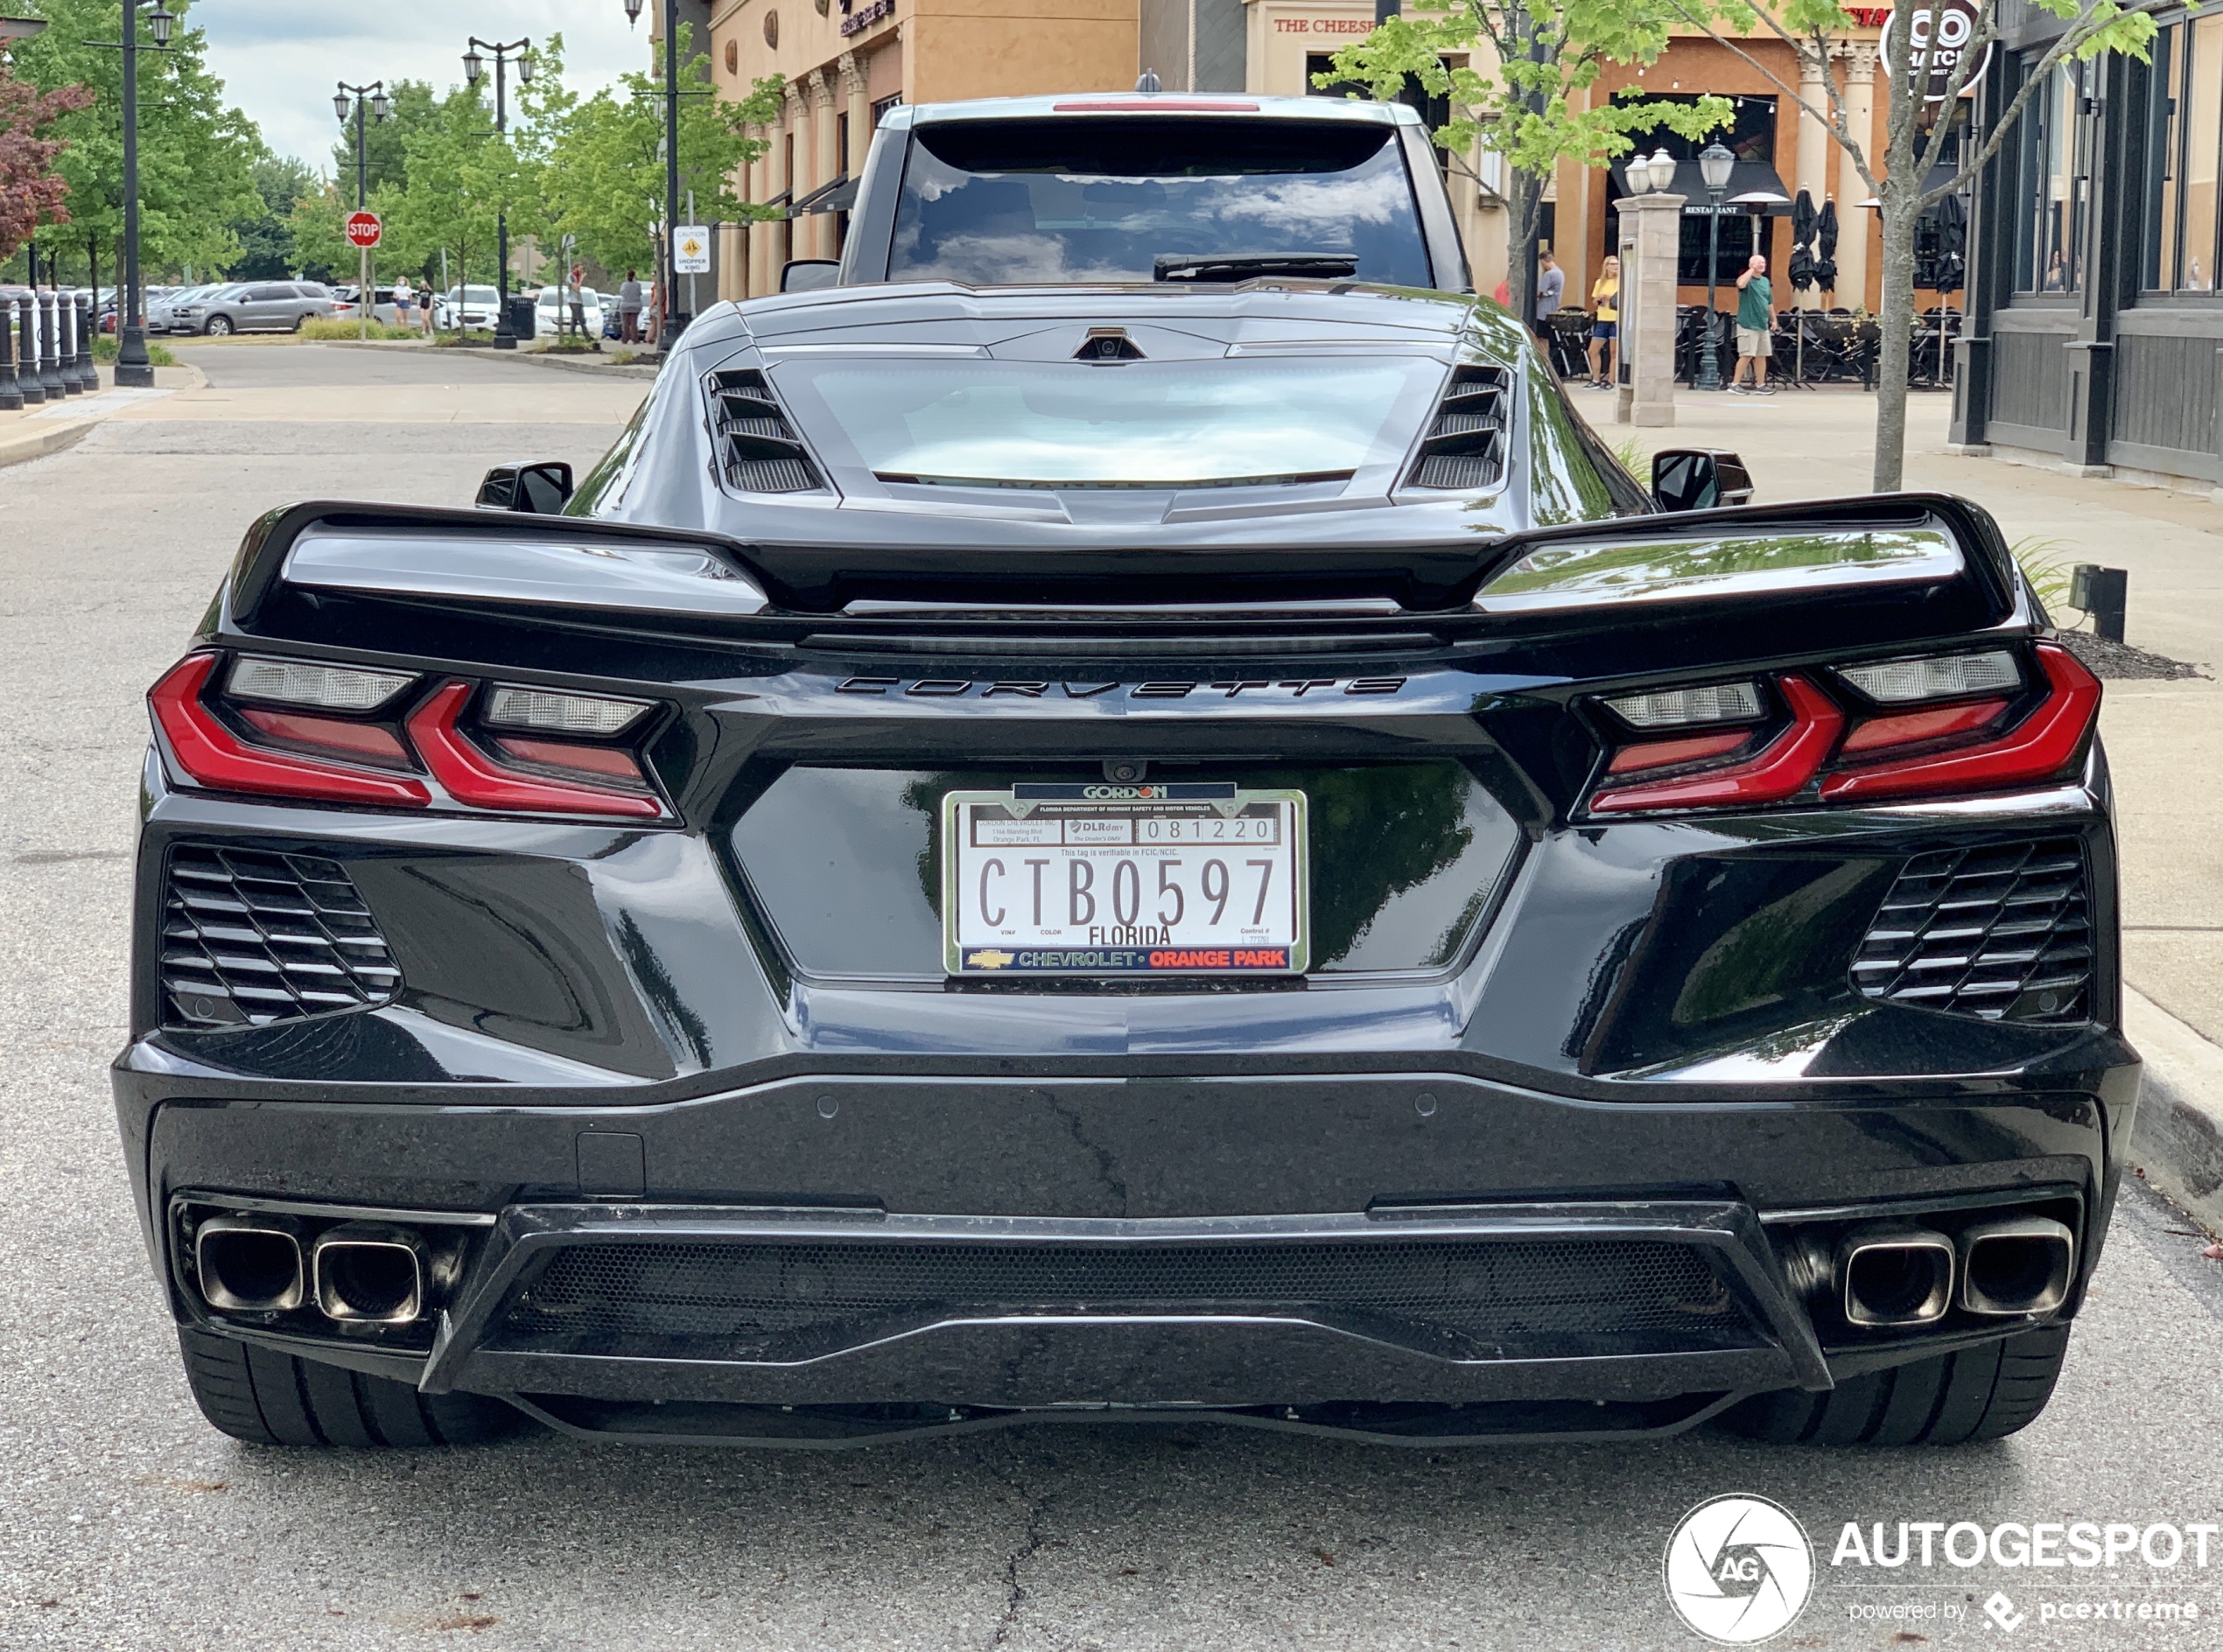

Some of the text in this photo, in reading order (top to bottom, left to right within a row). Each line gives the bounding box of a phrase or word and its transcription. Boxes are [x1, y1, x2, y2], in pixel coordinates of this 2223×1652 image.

[1274, 19, 1378, 33] THE CHEESE
[349, 223, 379, 236] STOP
[835, 676, 1406, 699] CORVETTE
[1083, 786, 1167, 799] GORDON
[1083, 822, 1124, 831] DLRdmv
[1077, 849, 1088, 858] tag
[979, 858, 1273, 927] CTB0597
[1089, 926, 1171, 944] FLORIDA
[1019, 950, 1286, 967] CHEVROLET ORANGE PARK
